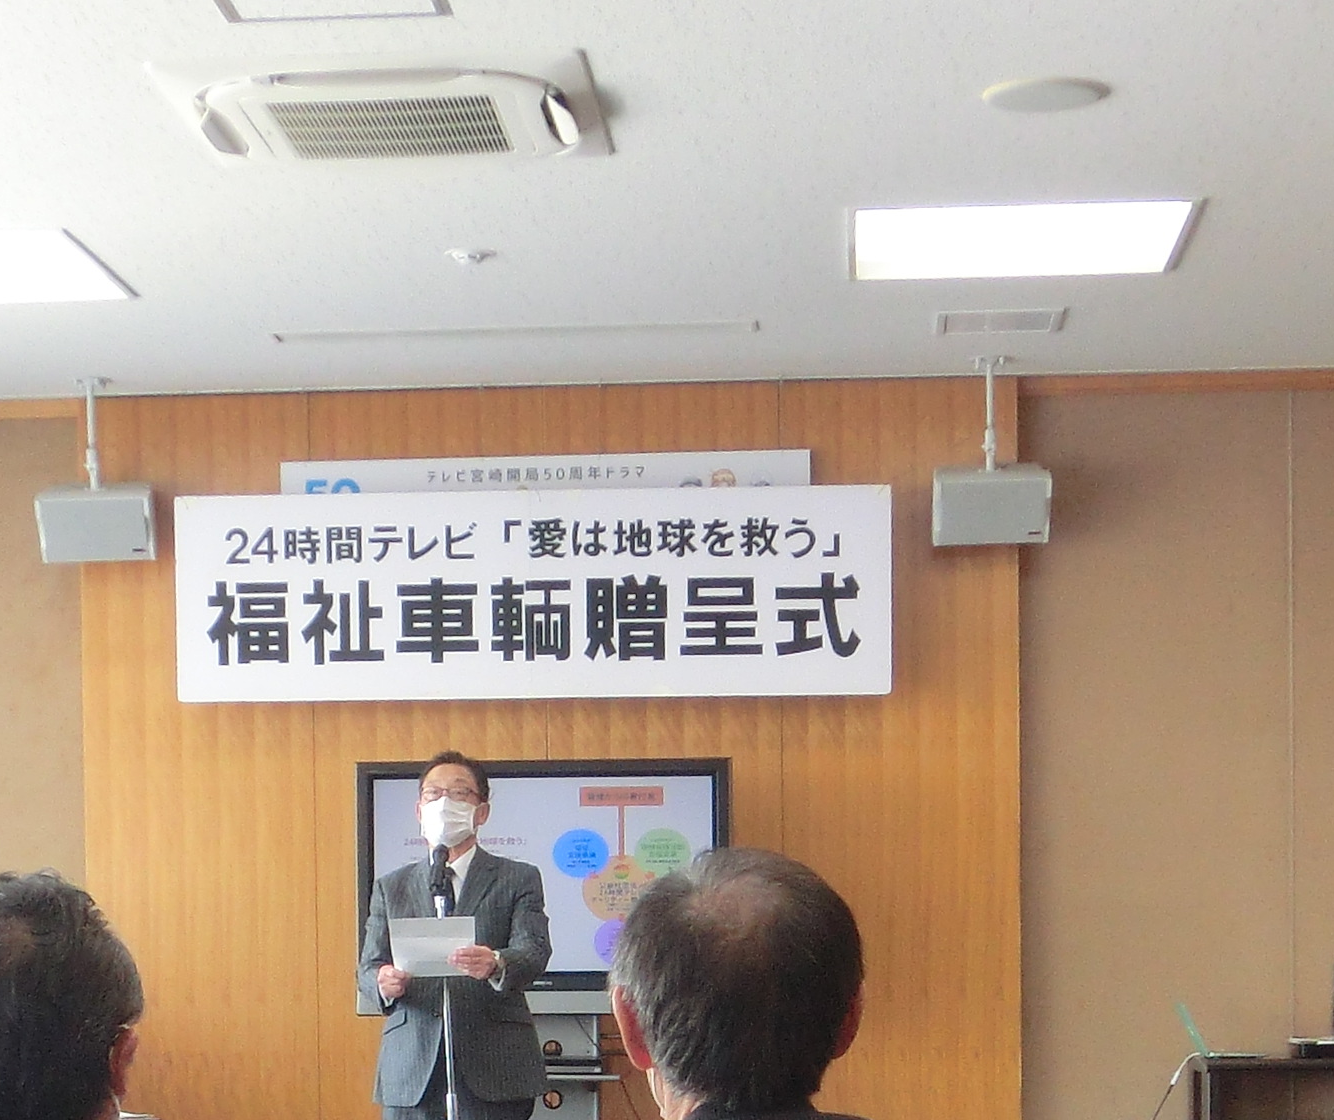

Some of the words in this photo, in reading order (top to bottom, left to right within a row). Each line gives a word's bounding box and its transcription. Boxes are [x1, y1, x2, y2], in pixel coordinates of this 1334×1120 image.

[426, 465, 647, 484] テレビ宮崎開局50周年ドラマ
[224, 516, 841, 565] 24時間テレビ「愛は地球を救う」
[206, 571, 862, 667] 福祉車輌贈呈式
